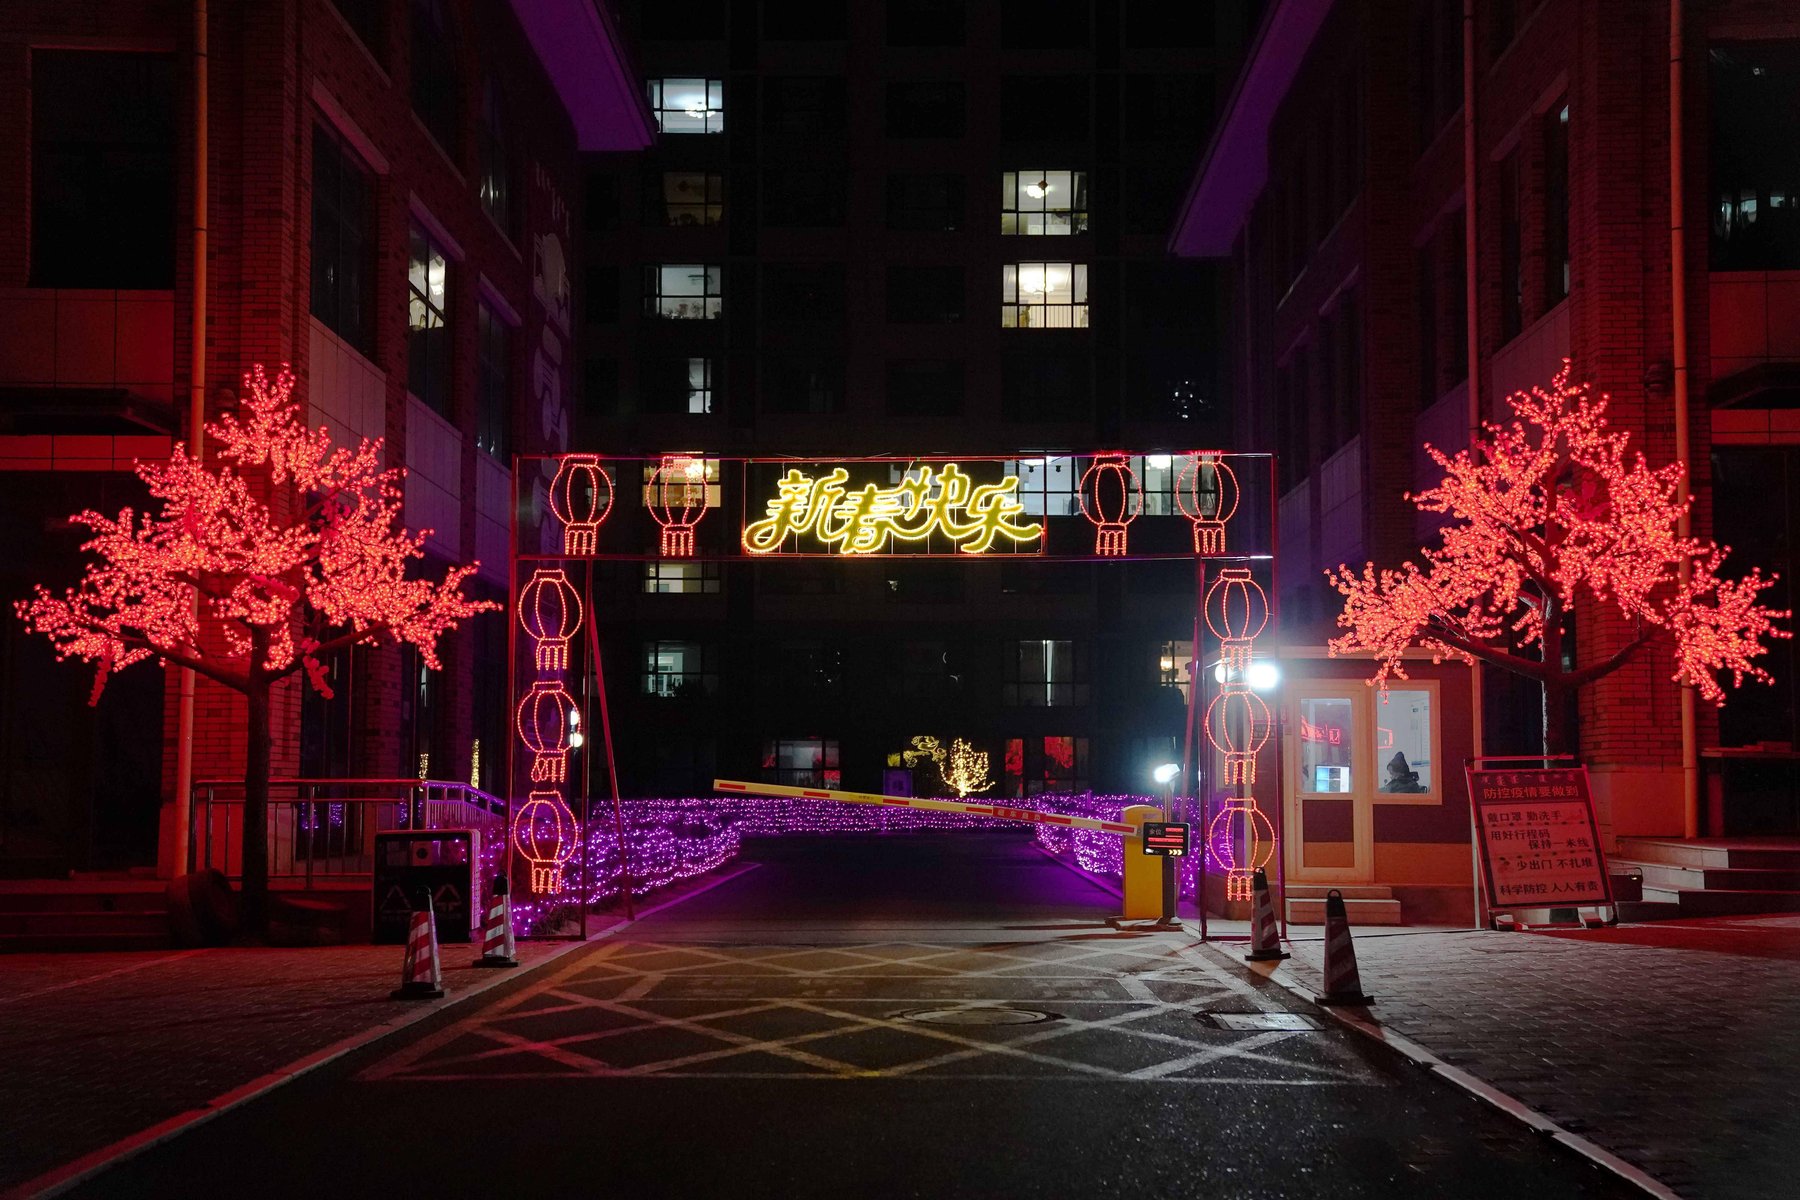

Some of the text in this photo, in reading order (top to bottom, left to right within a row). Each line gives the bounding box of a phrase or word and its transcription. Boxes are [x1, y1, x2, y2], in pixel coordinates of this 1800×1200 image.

[744, 464, 1043, 554] 新春快乐
[1484, 786, 1578, 799] 防控疫情要做到
[1487, 810, 1561, 822] 戴口罩 勤洗手
[1491, 828, 1549, 840] 用好行程码
[1528, 837, 1589, 849] 保持一米线
[1517, 857, 1593, 871] 少出门 不扎堆
[1500, 880, 1598, 895] 科学防控 人人有责
